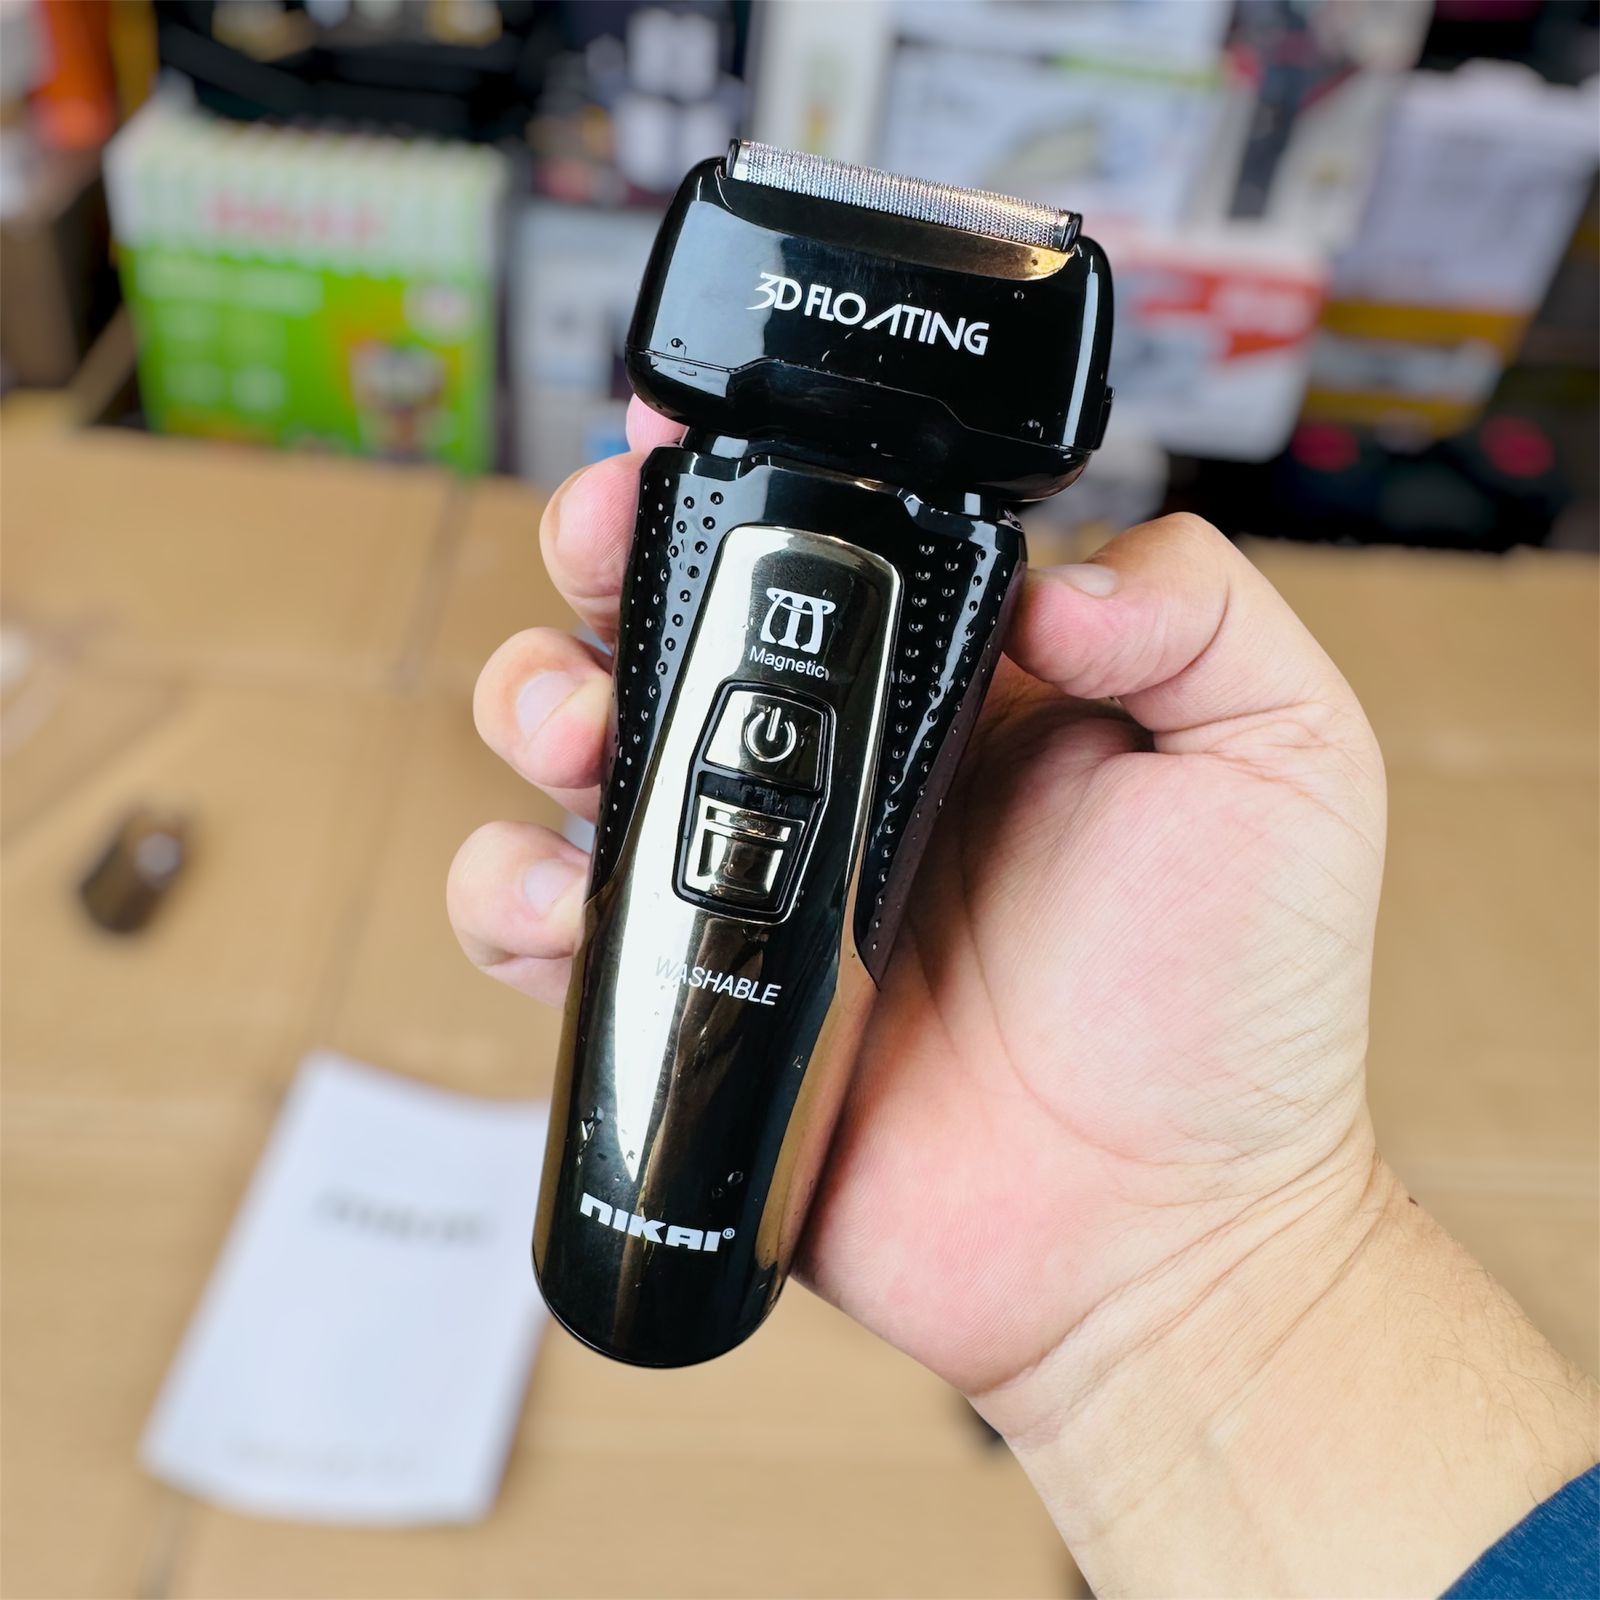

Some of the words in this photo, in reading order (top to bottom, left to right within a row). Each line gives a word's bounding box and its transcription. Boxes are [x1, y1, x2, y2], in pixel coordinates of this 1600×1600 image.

[745, 272, 802, 311] 3D
[749, 645, 825, 678] Magnetic
[655, 956, 782, 1006] WASHABLE
